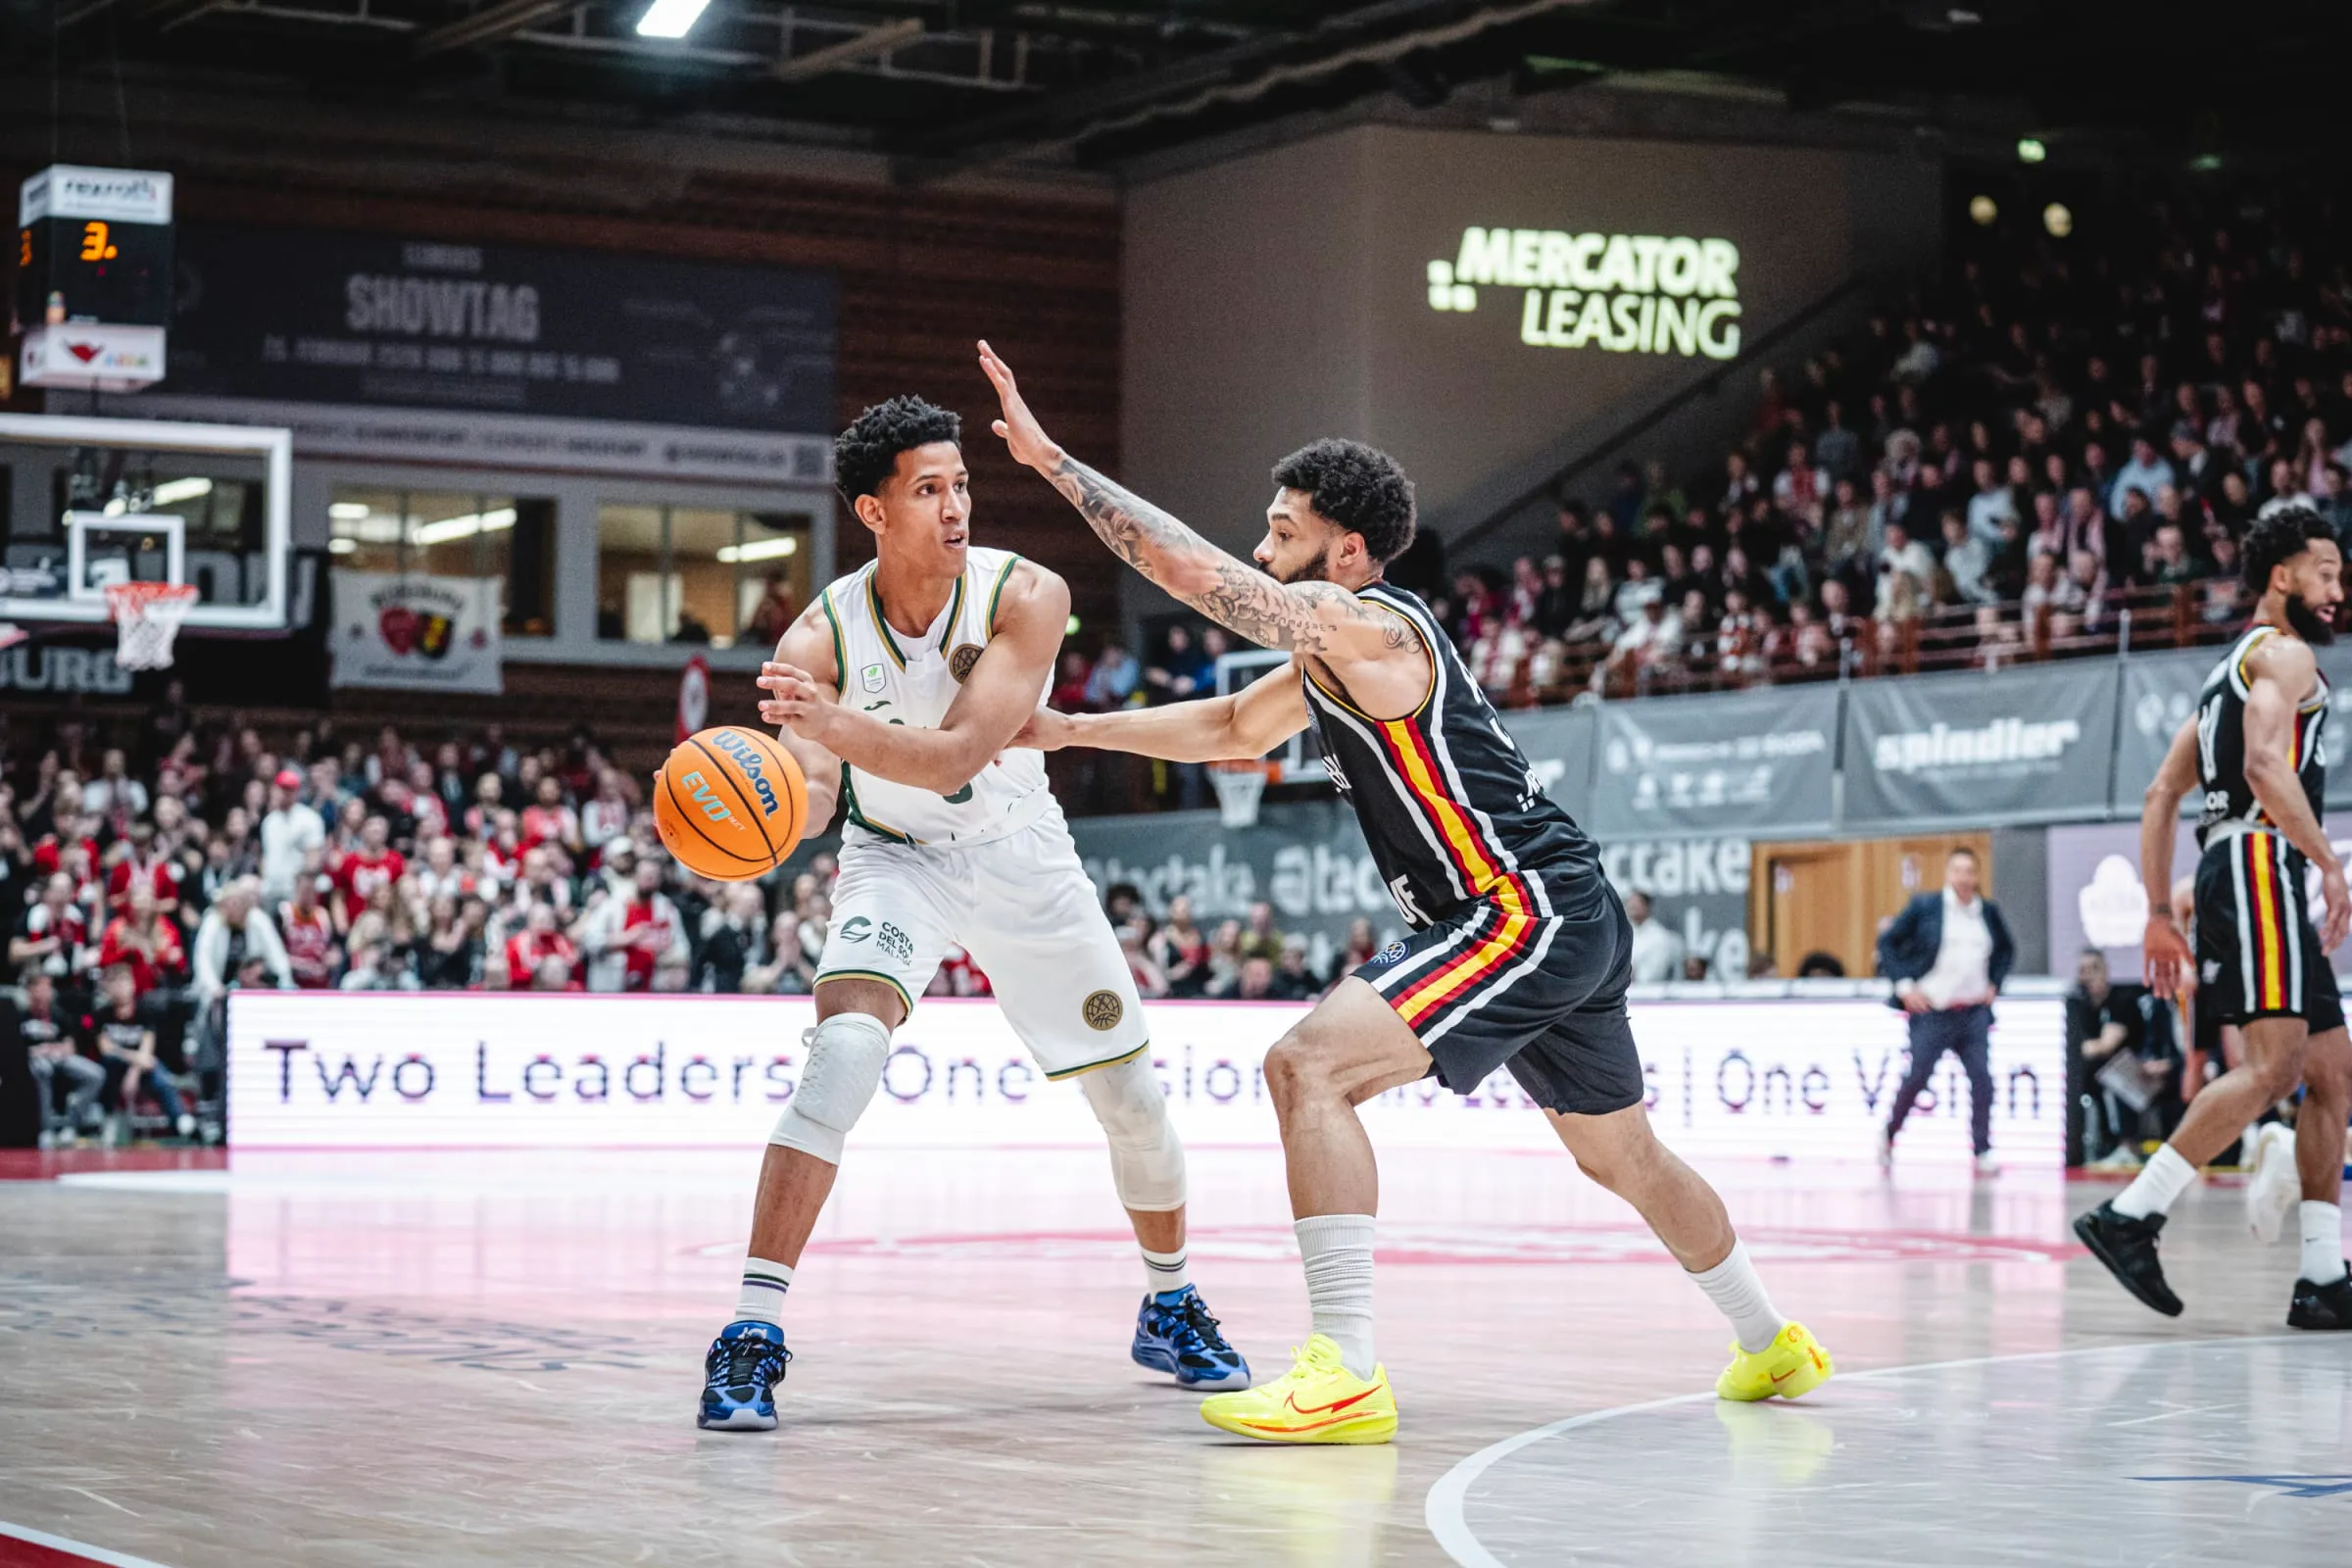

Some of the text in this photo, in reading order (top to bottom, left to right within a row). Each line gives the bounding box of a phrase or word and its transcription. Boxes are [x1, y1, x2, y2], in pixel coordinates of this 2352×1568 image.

[1454, 225, 1740, 298] MERCATOR
[344, 272, 541, 343] SHOWTAG
[1520, 288, 1742, 362] LEASING
[710, 729, 780, 820] Wilson
[1876, 716, 2080, 775] spindler
[680, 770, 732, 822] EVO
[878, 931, 897, 949] DEL
[881, 921, 913, 955] COSTA
[265, 1039, 435, 1103] Two
[477, 1040, 796, 1105] Leaders
[883, 1044, 1033, 1105] One
[1717, 1048, 1830, 1114] One
